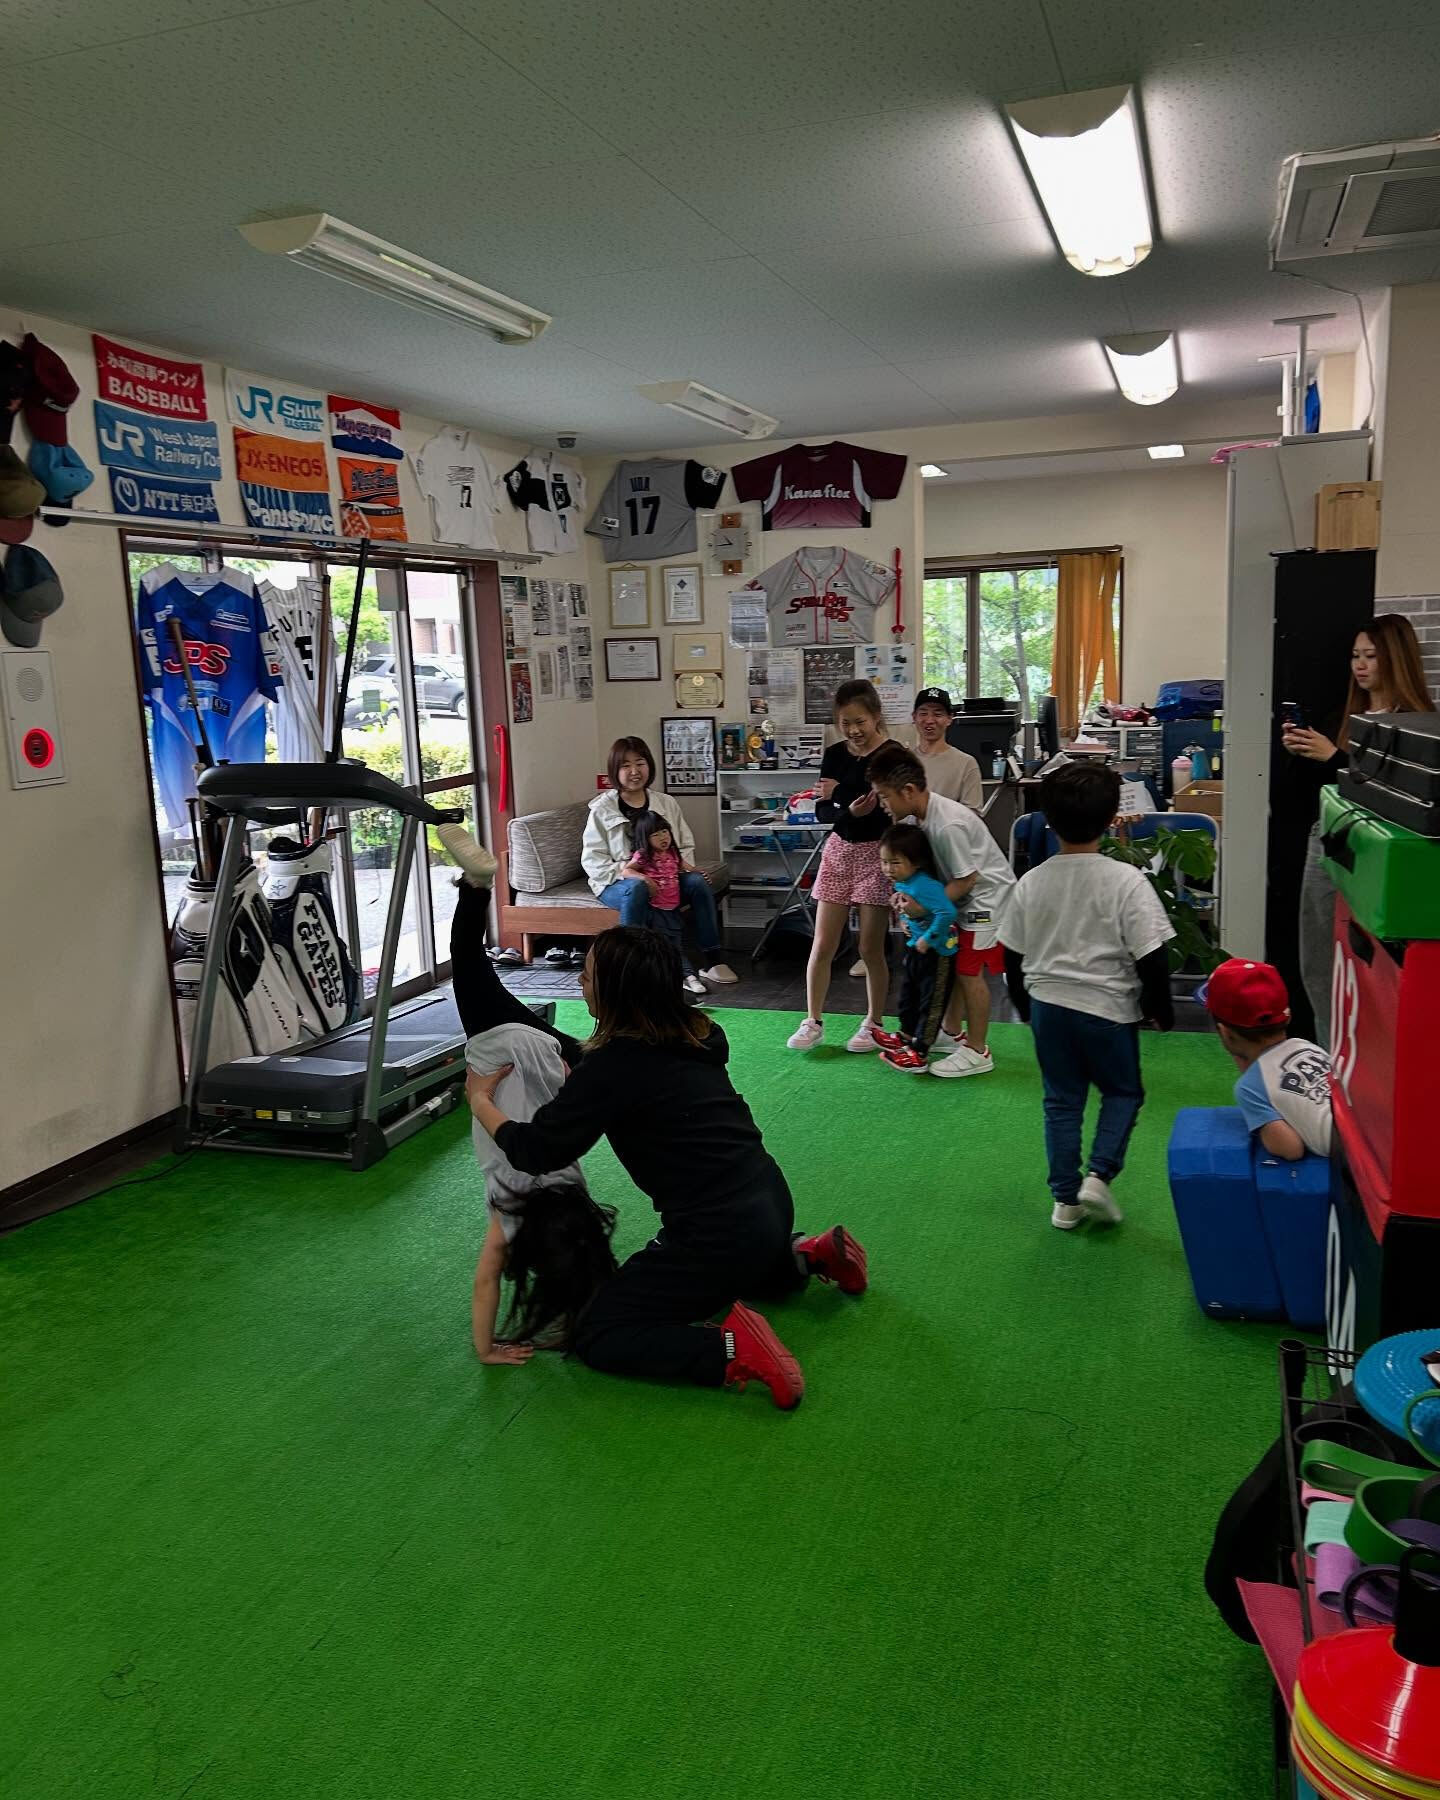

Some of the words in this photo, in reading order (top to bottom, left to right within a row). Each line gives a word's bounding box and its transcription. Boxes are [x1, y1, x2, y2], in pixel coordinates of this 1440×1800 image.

[108, 376, 199, 413] BASEBALL
[235, 386, 275, 424] JR
[99, 421, 145, 458] JR
[148, 426, 186, 446] West
[187, 432, 217, 451] Japan
[154, 445, 201, 468] Railway
[244, 449, 322, 477] JX-ENEOS
[784, 484, 851, 500] Kanaflex
[245, 498, 334, 532] Panasonic
[625, 496, 660, 536] 17
[297, 921, 337, 1009] GATES
[303, 900, 347, 1008] PEARLY
[725, 1332, 735, 1359] PUMA
